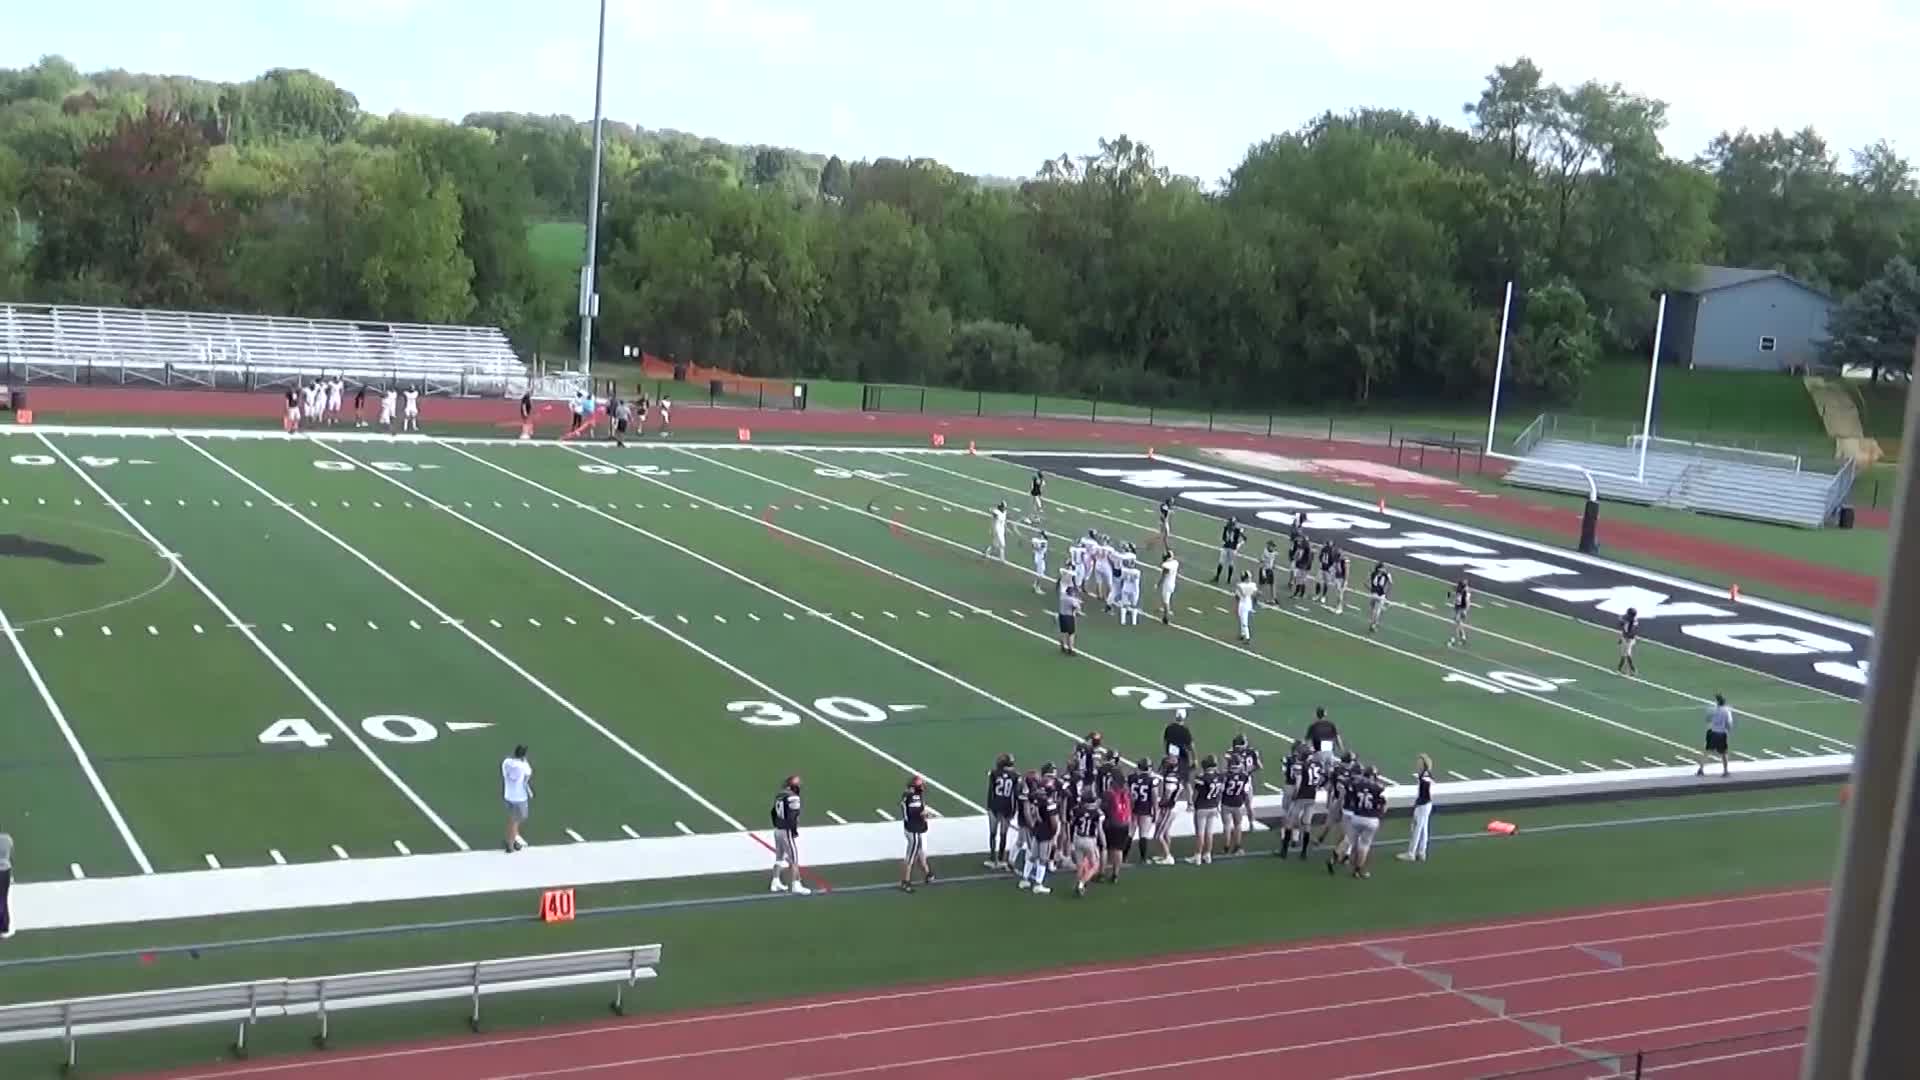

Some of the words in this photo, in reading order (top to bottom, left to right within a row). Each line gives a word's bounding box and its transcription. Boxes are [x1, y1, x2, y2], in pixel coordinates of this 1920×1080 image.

[1442, 671, 1558, 693] 10
[1110, 683, 1255, 709] 20
[726, 696, 888, 725] 30
[257, 714, 439, 747] 40
[549, 892, 571, 916] 40
